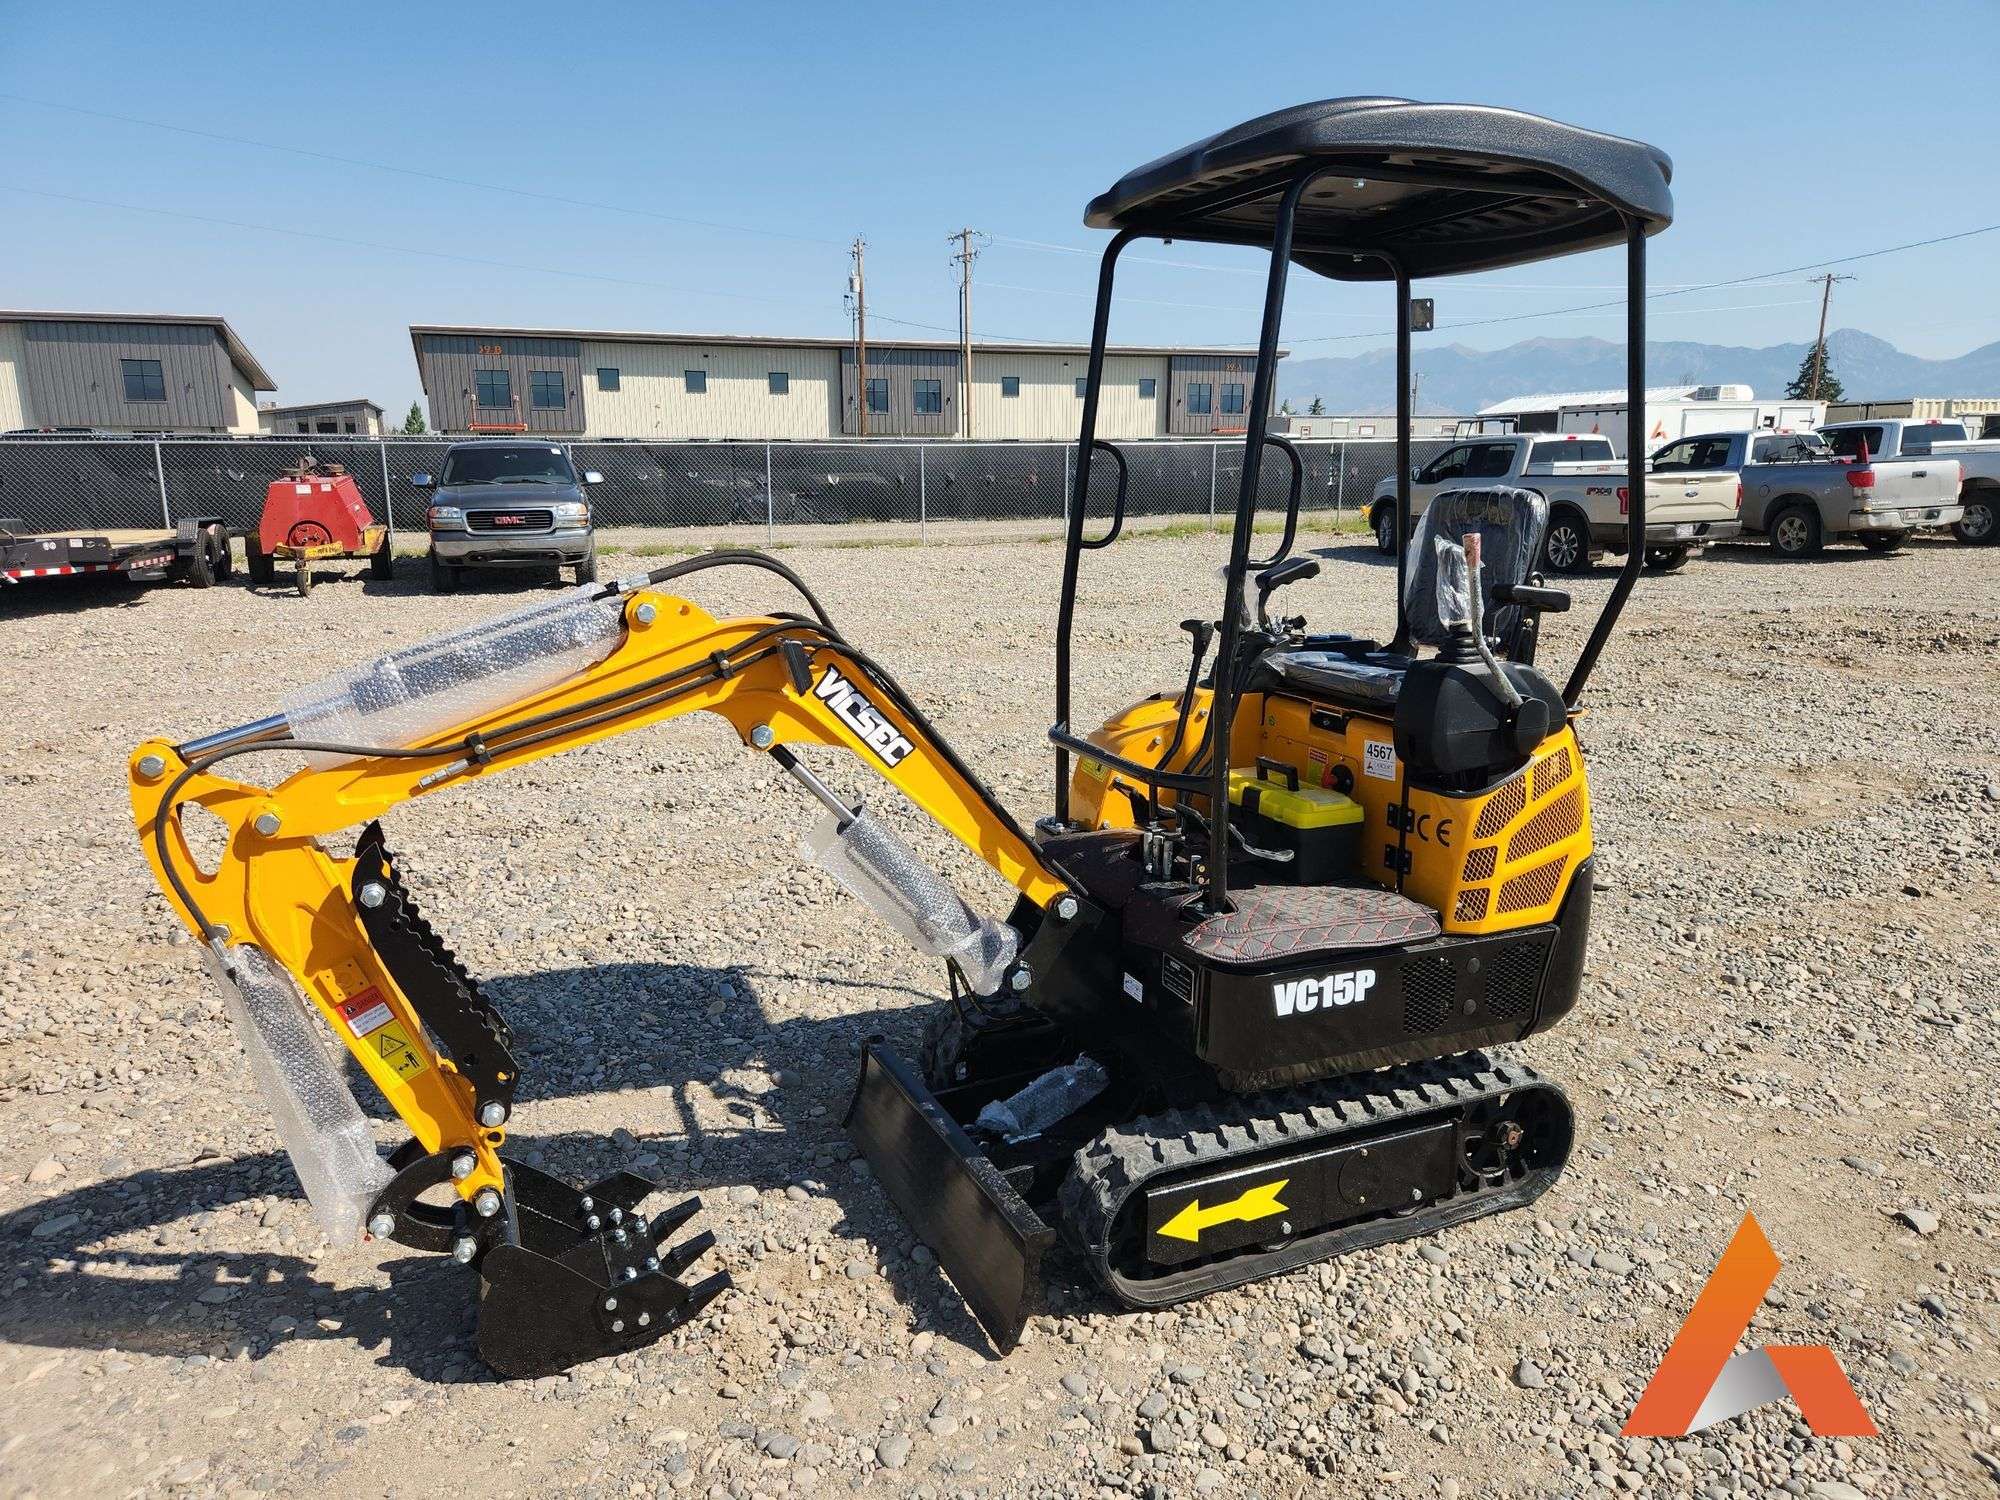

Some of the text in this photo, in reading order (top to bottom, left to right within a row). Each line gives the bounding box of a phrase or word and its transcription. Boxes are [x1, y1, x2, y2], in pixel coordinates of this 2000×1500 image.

[495, 516, 525, 524] GMC
[815, 666, 914, 767] VICSEC
[1366, 743, 1393, 760] 4567
[1273, 969, 1376, 1017] VC15P
